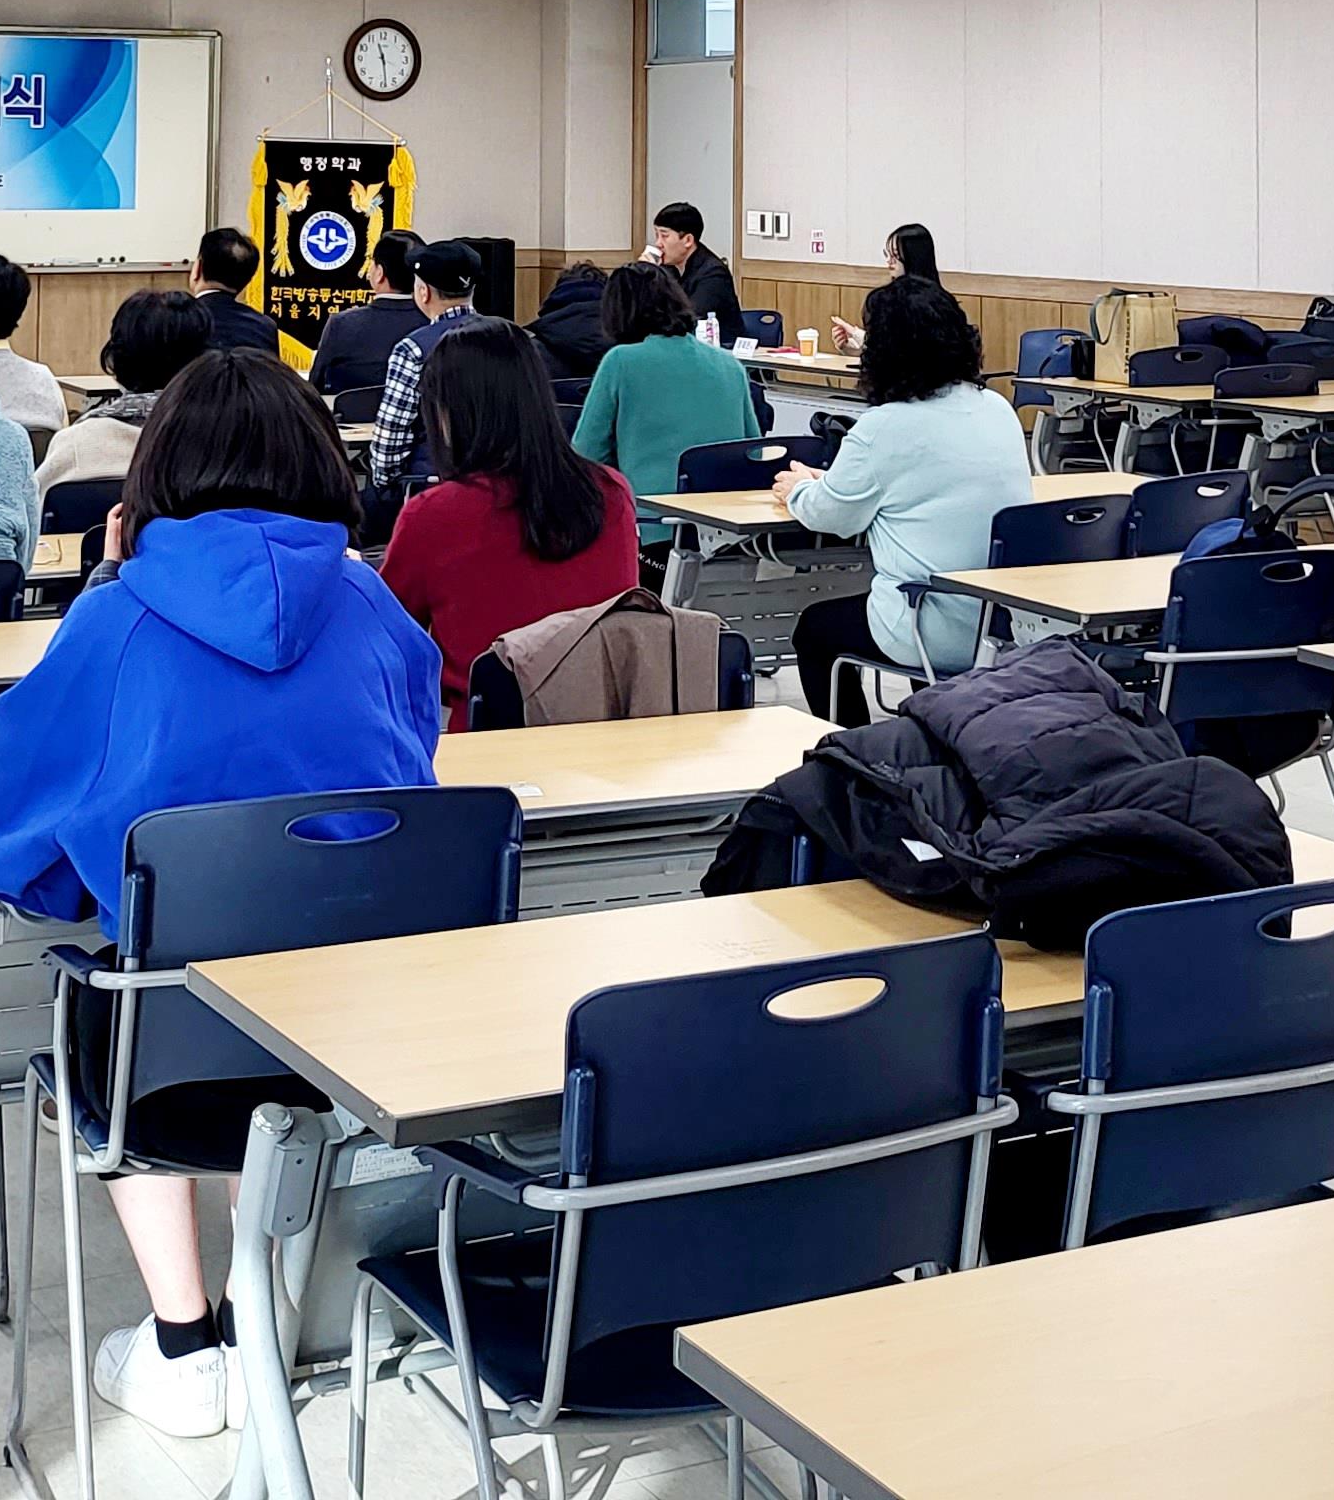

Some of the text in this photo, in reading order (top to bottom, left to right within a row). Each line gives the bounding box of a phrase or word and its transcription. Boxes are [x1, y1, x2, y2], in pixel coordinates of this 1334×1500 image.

[368, 34, 375, 44] 11
[380, 31, 388, 41] 12
[394, 35, 397, 44] 1
[359, 43, 368, 53] 10
[401, 44, 406, 53] 2
[402, 56, 408, 65] 3
[360, 67, 367, 76] 8
[398, 68, 405, 77] 4
[368, 77, 374, 85] 7
[299, 156, 362, 172] 행정학과
[196, 1359, 220, 1375] NIKE
